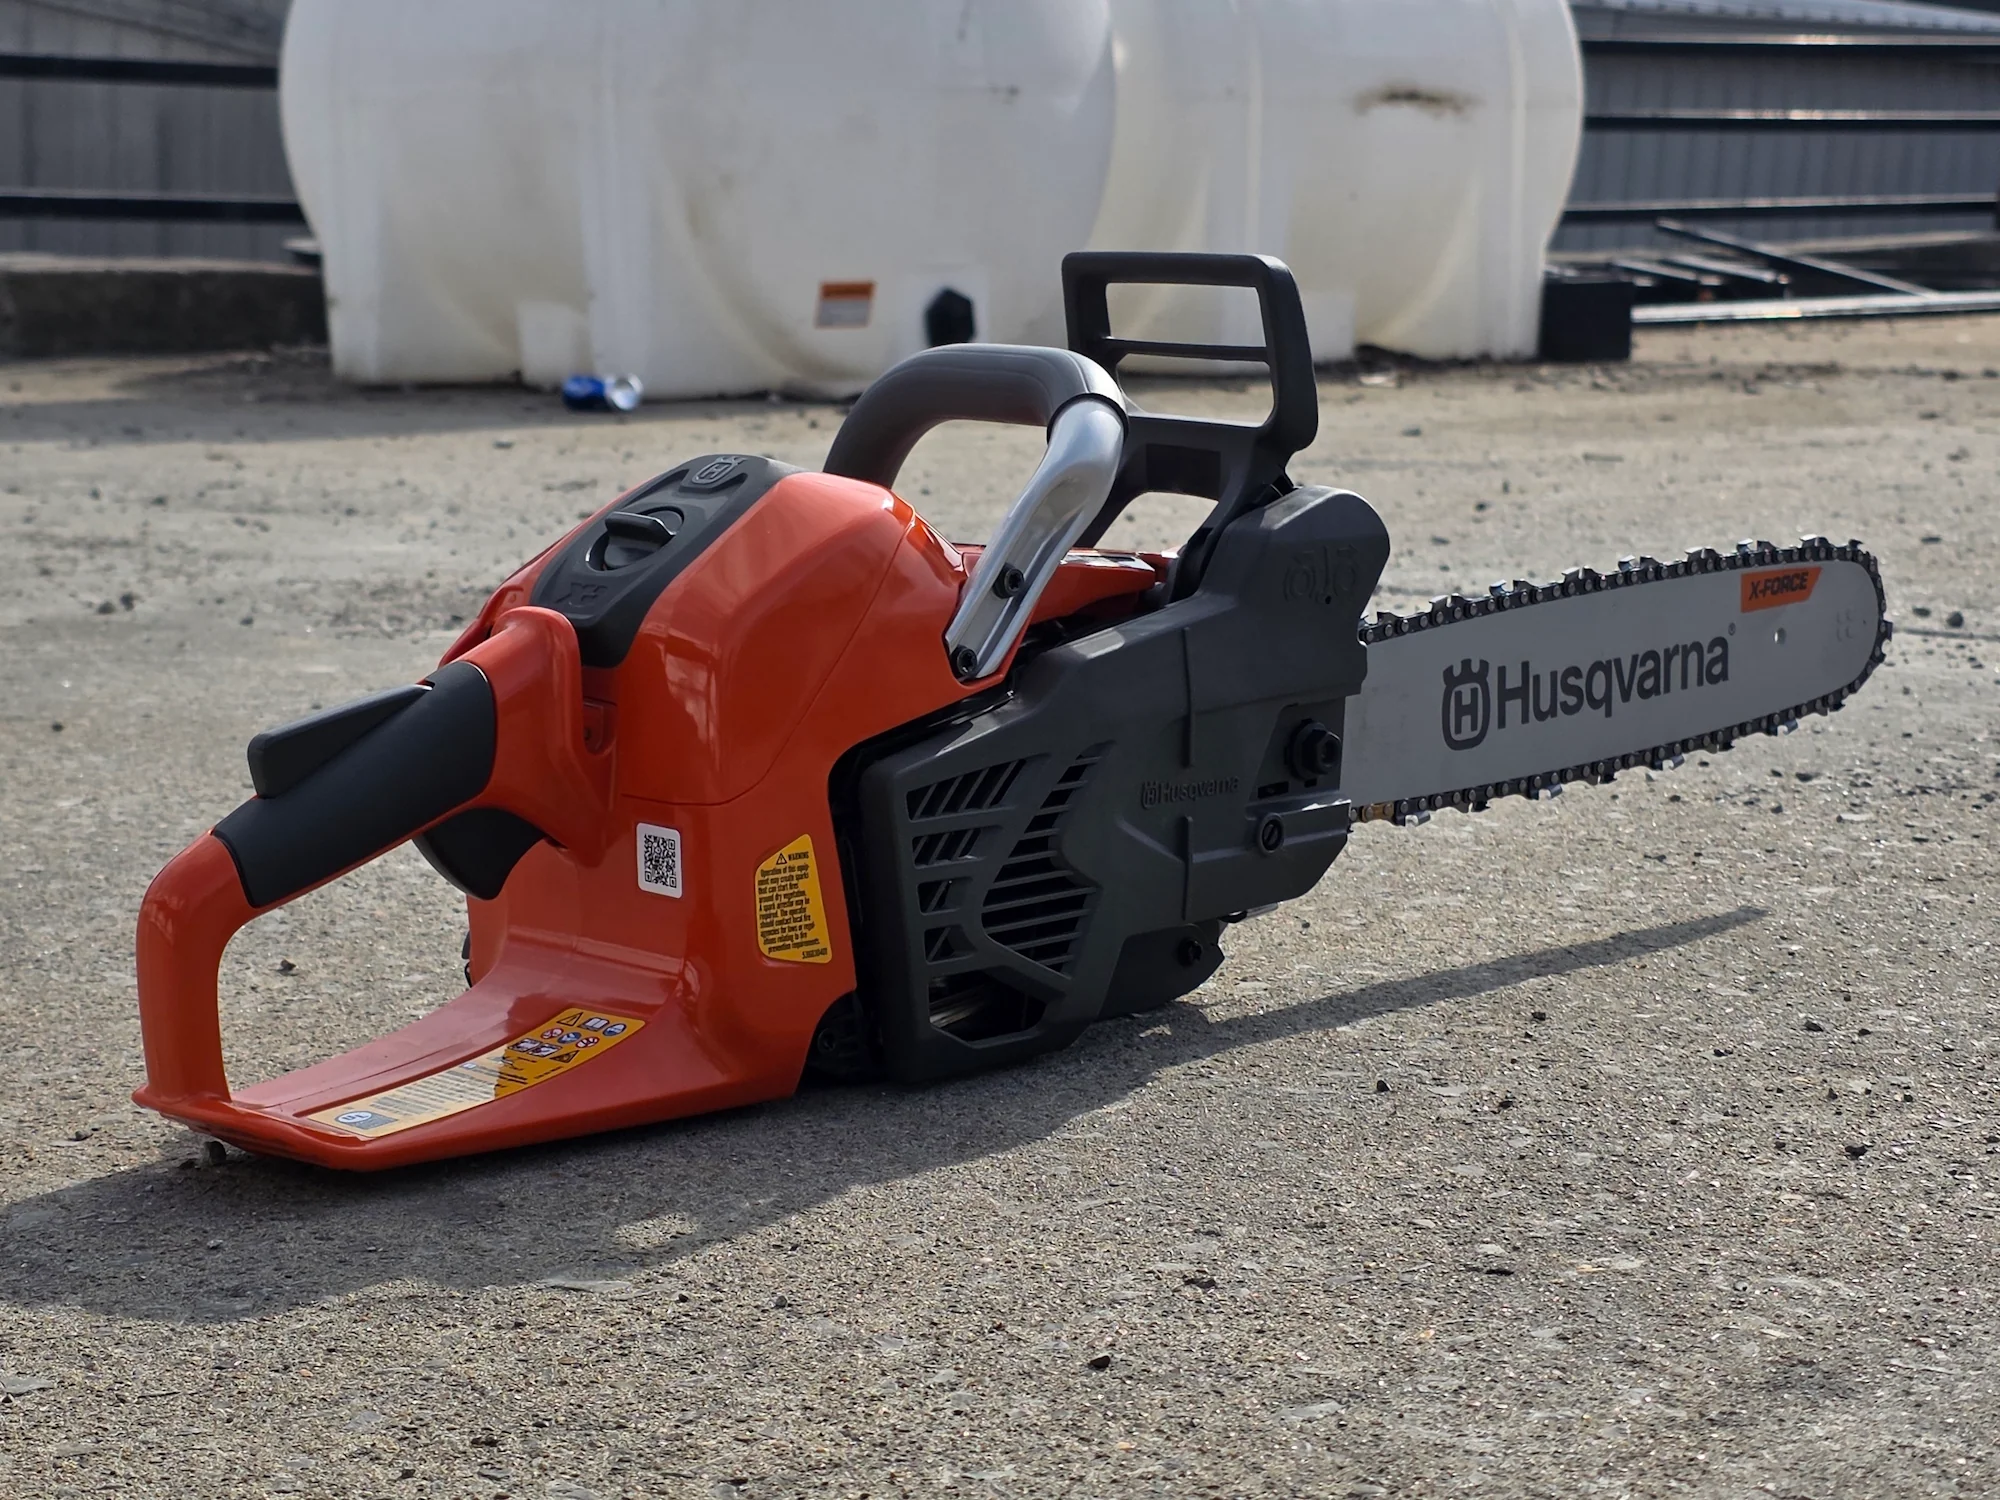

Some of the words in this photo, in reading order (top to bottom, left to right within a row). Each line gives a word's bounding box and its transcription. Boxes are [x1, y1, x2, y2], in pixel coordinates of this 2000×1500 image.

[1748, 572, 1810, 601] X-FORCE
[1497, 635, 1729, 729] Husqvarna
[1158, 776, 1240, 802] Husqvarna
[788, 851, 809, 861] WARNING
